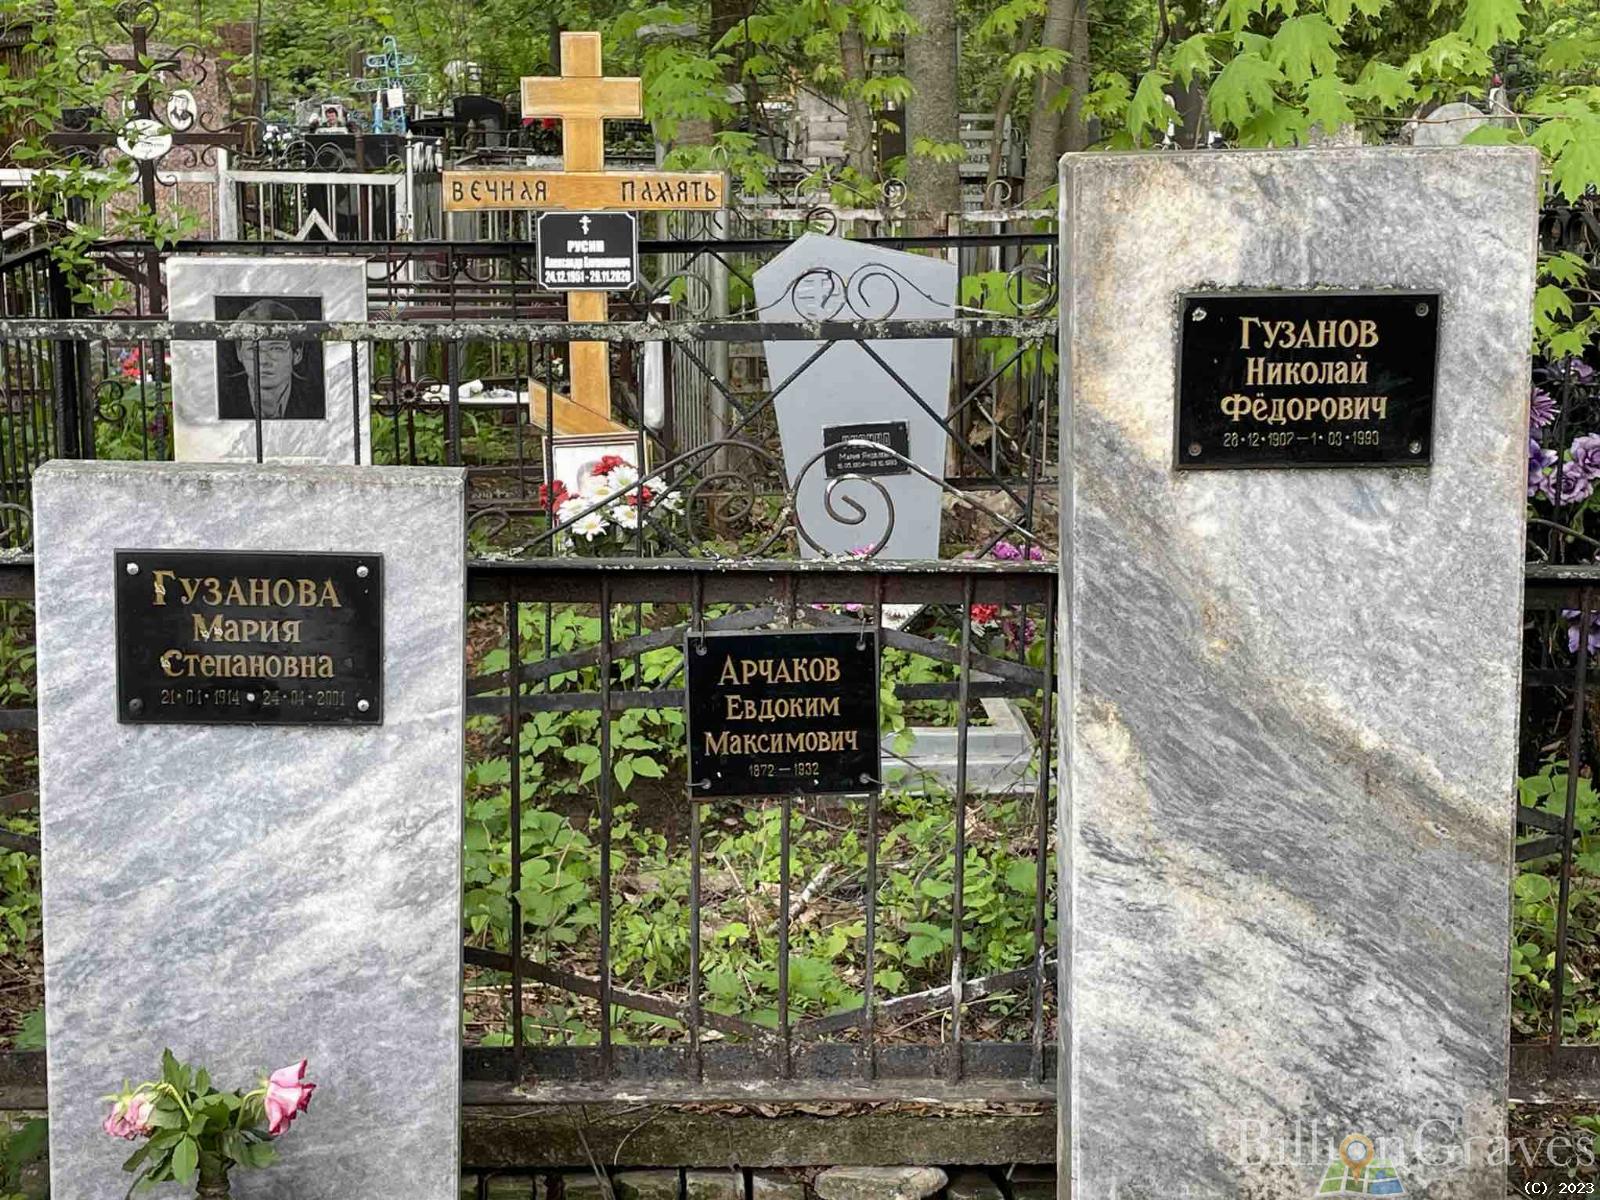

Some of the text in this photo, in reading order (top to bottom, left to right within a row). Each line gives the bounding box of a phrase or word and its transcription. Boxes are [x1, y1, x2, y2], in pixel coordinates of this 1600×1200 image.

[452, 180, 718, 202] ВЕЧНАЯ ПАМЯТЬ
[1245, 354, 1369, 386] Николай
[1220, 392, 1389, 426] Фёдорович
[192, 613, 303, 643] Мария
[160, 649, 336, 678] Степановна
[724, 694, 841, 723] Евдоким
[704, 730, 860, 757] Максимович
